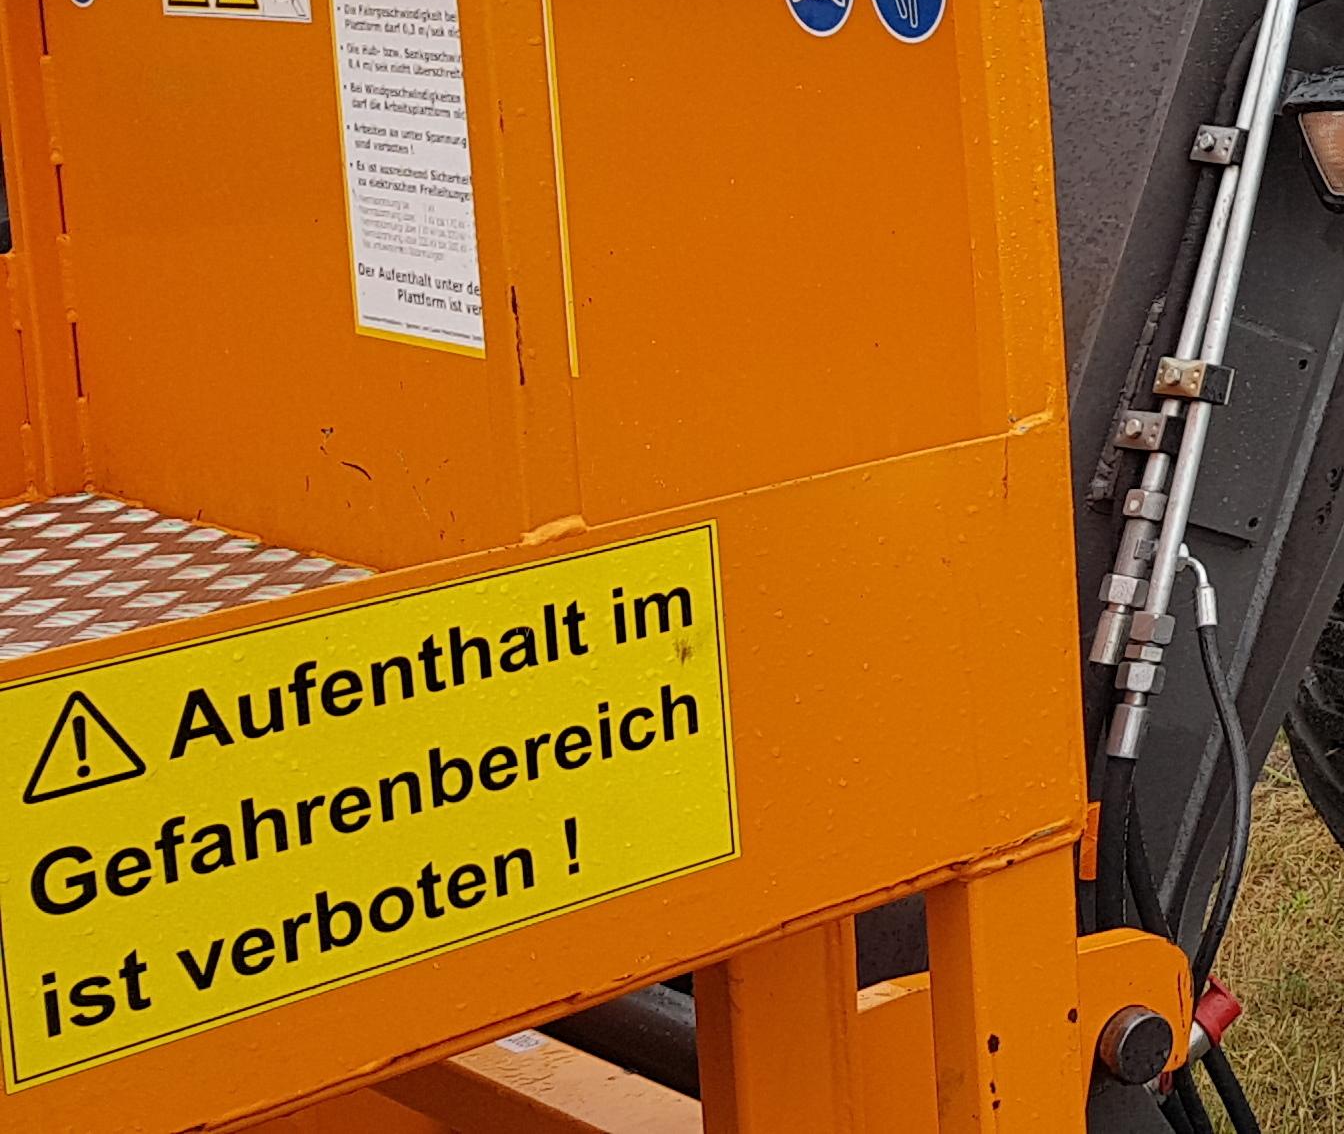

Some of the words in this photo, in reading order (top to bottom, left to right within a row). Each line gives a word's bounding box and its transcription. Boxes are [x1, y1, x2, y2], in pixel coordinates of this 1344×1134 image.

[378, 266, 433, 289] Aufenthalt
[170, 601, 588, 760] Aufenthalt
[612, 585, 693, 645] im
[30, 683, 699, 916] Gefahrenbereich
[43, 948, 152, 1038] ist
[176, 843, 536, 991] verboten
[562, 816, 581, 877] !
